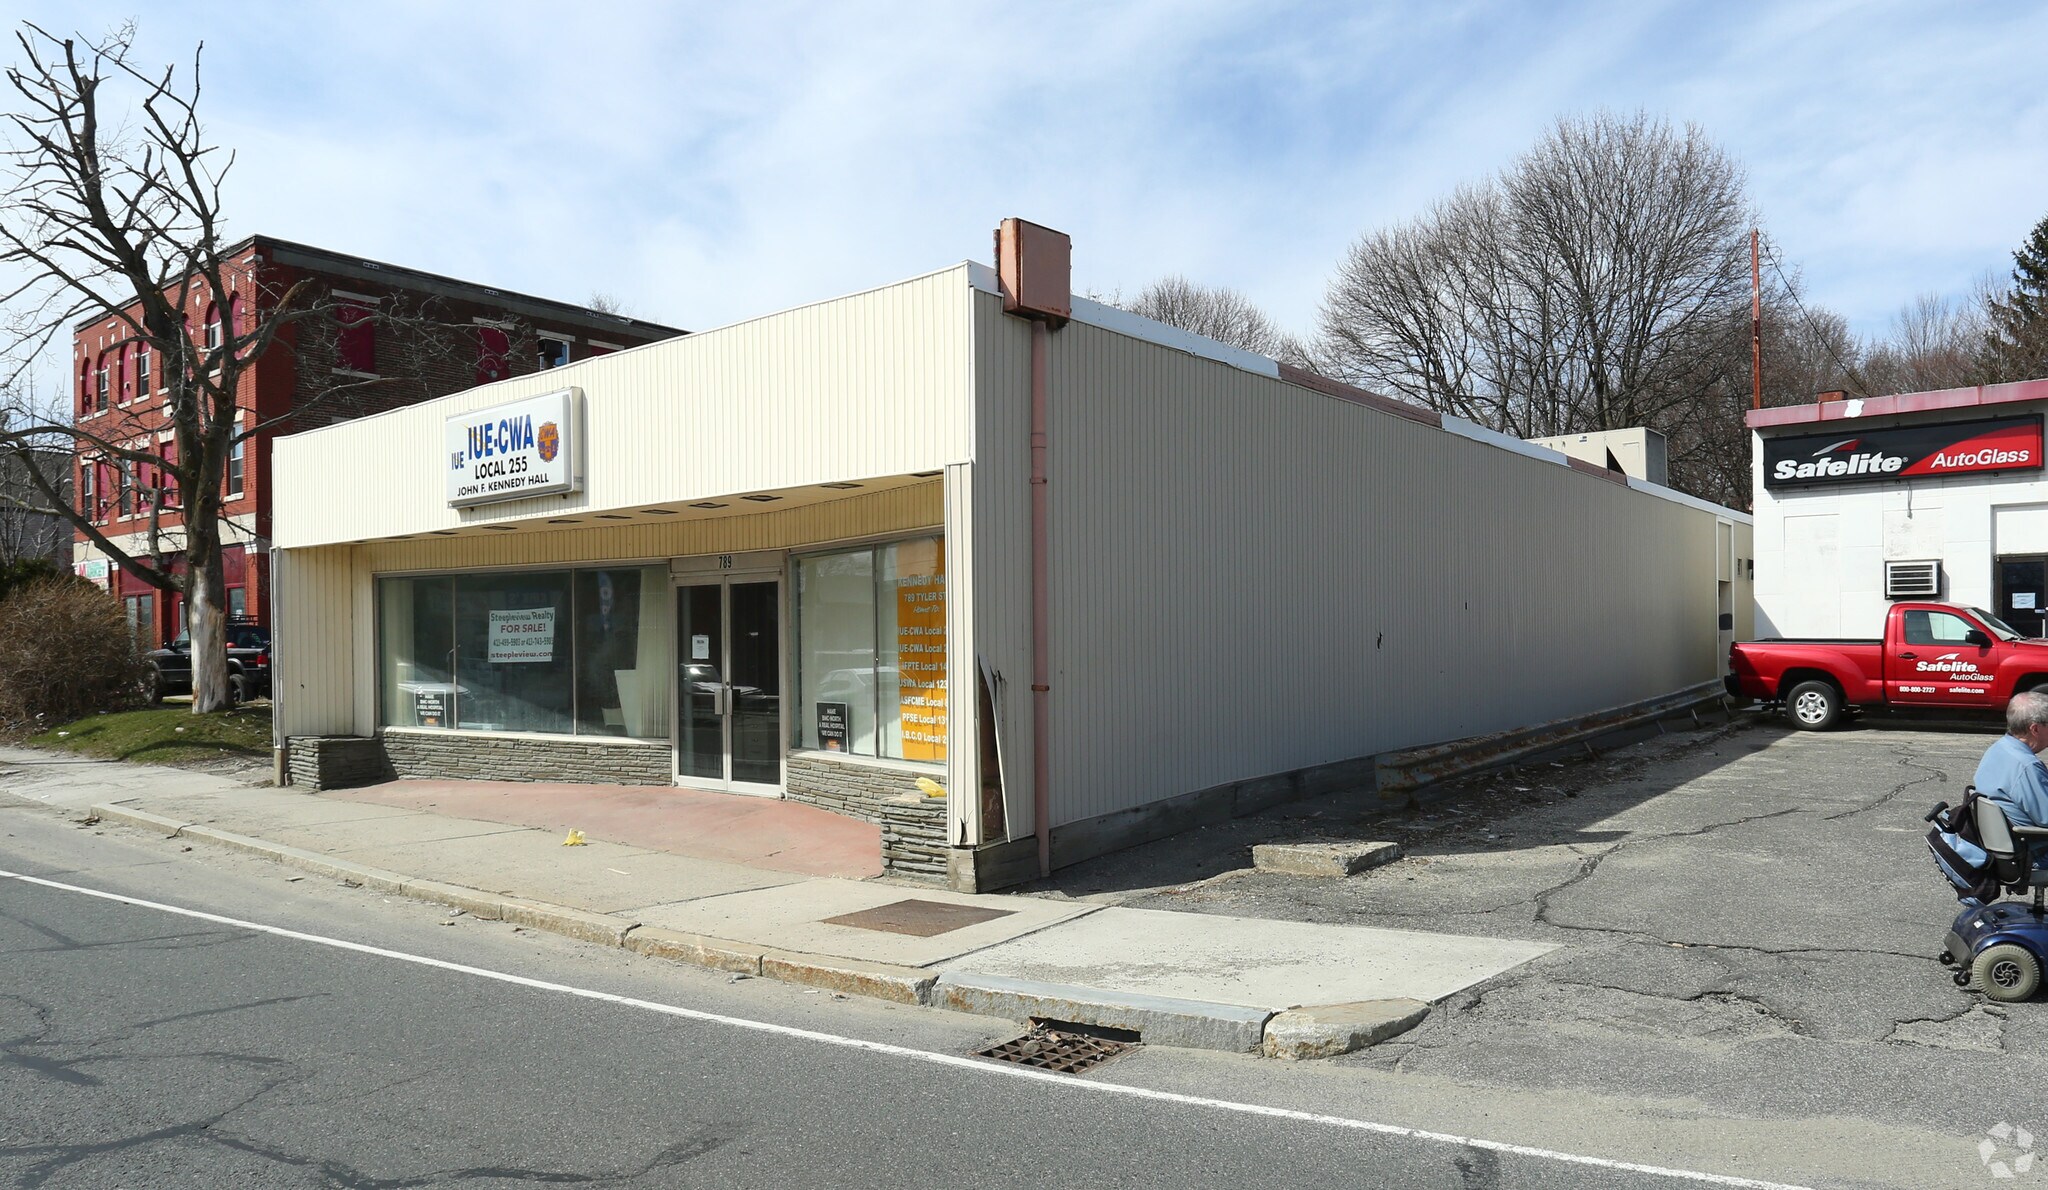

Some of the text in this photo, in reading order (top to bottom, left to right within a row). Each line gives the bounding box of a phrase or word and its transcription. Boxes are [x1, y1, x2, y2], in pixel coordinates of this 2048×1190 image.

[468, 414, 534, 460] IUE-CWA
[451, 451, 464, 470] IUE
[1773, 448, 2030, 480] Safelite AutoGlass
[475, 456, 528, 480] LOCAL 255
[457, 473, 549, 497] JOHN F. KENNEDY HALL
[719, 555, 732, 569] 789
[897, 575, 932, 587] KENNEDY
[916, 592, 937, 602] TYLER
[491, 610, 554, 623] Steepleview Realty
[500, 623, 546, 633] FOR SALE!
[924, 626, 942, 635] Local
[924, 643, 942, 653] Local
[921, 662, 938, 671] Local
[1916, 661, 1977, 673] Safelite
[1949, 672, 1994, 682] AutoGlass
[917, 679, 935, 689] Local
[1949, 686, 1985, 695] safelite.com
[926, 697, 943, 707] Local
[902, 713, 918, 723] PFSE
[919, 714, 936, 724] Local
[923, 732, 940, 743] Local
